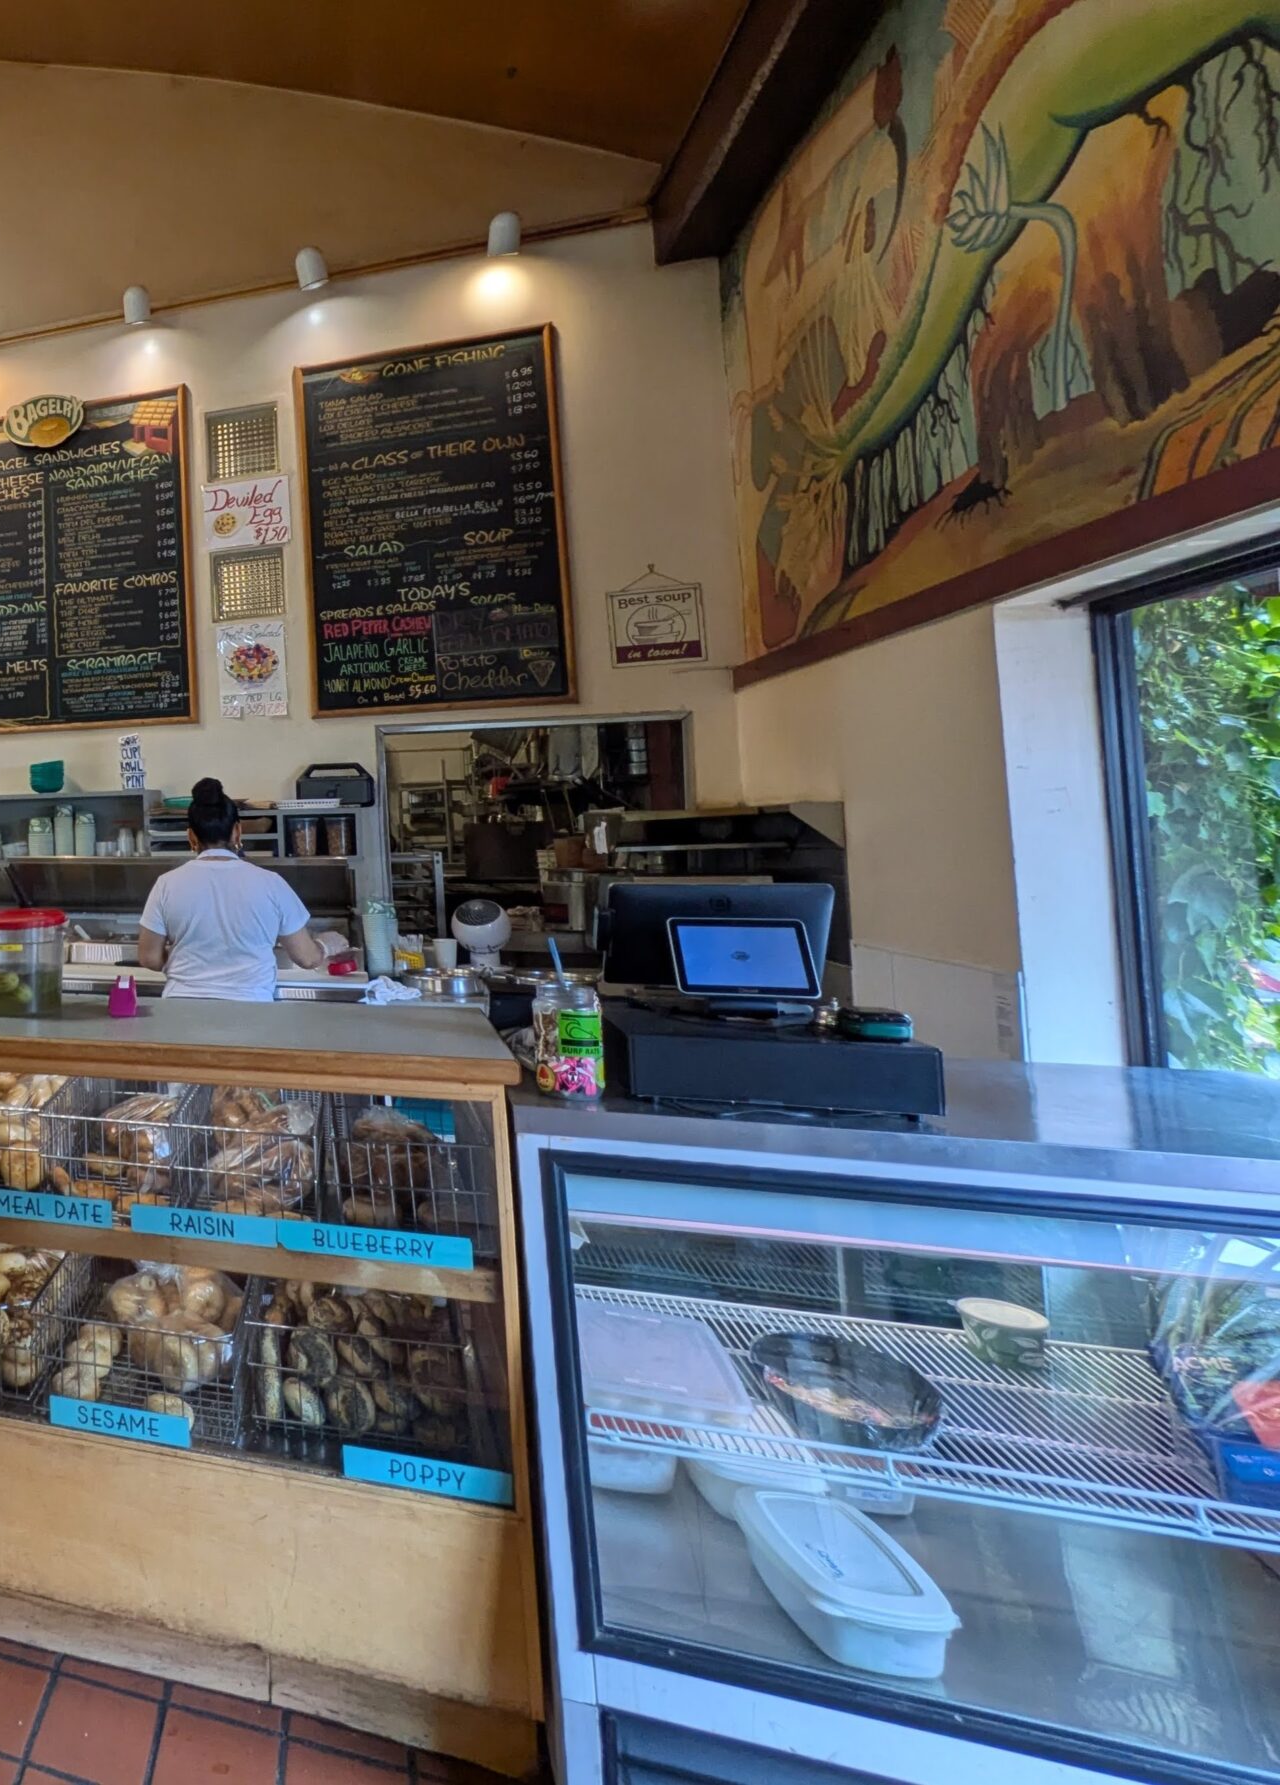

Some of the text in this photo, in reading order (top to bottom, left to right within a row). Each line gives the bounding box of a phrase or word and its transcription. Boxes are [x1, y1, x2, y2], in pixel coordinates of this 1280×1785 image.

[382, 345, 505, 377] GONE FISHING
[9, 395, 84, 438] BAGELRY
[33, 441, 120, 466] SANDWICHES
[351, 449, 409, 471] CLASS
[426, 440, 477, 459] THEIR
[482, 434, 526, 453] OWN
[65, 467, 160, 491] SANDWICHES
[204, 479, 282, 512] Deviled
[245, 504, 283, 527] Egg
[463, 528, 514, 545] SOUP
[343, 541, 405, 558] SALAD
[55, 570, 177, 596] FAVORITE COMBOS
[397, 581, 471, 602] TODAY'S
[470, 592, 516, 605] SOUPS
[618, 592, 692, 609] Best soup
[320, 606, 374, 621] SPREADS
[385, 601, 437, 614] SALADS
[323, 623, 349, 640] RED
[351, 618, 389, 637] PEPPER
[391, 615, 432, 632] CASHEW
[383, 637, 429, 657] GARLIC
[627, 643, 688, 659] in town!
[6, 659, 48, 675] MELTS
[340, 660, 392, 676] ARTICHOKE
[437, 655, 497, 671] Potato
[324, 677, 349, 694] HONEY
[352, 676, 391, 693] ALMOND
[442, 665, 528, 690] Cheddar
[561, 1046, 583, 1055] SURF
[53, 1201, 104, 1224] DATE
[169, 1211, 236, 1239] RAISIN
[312, 1227, 437, 1260] BLUEBERRY
[1172, 1355, 1238, 1374] ACME
[77, 1403, 161, 1438] SESAME
[388, 1457, 467, 1492] POPPY
